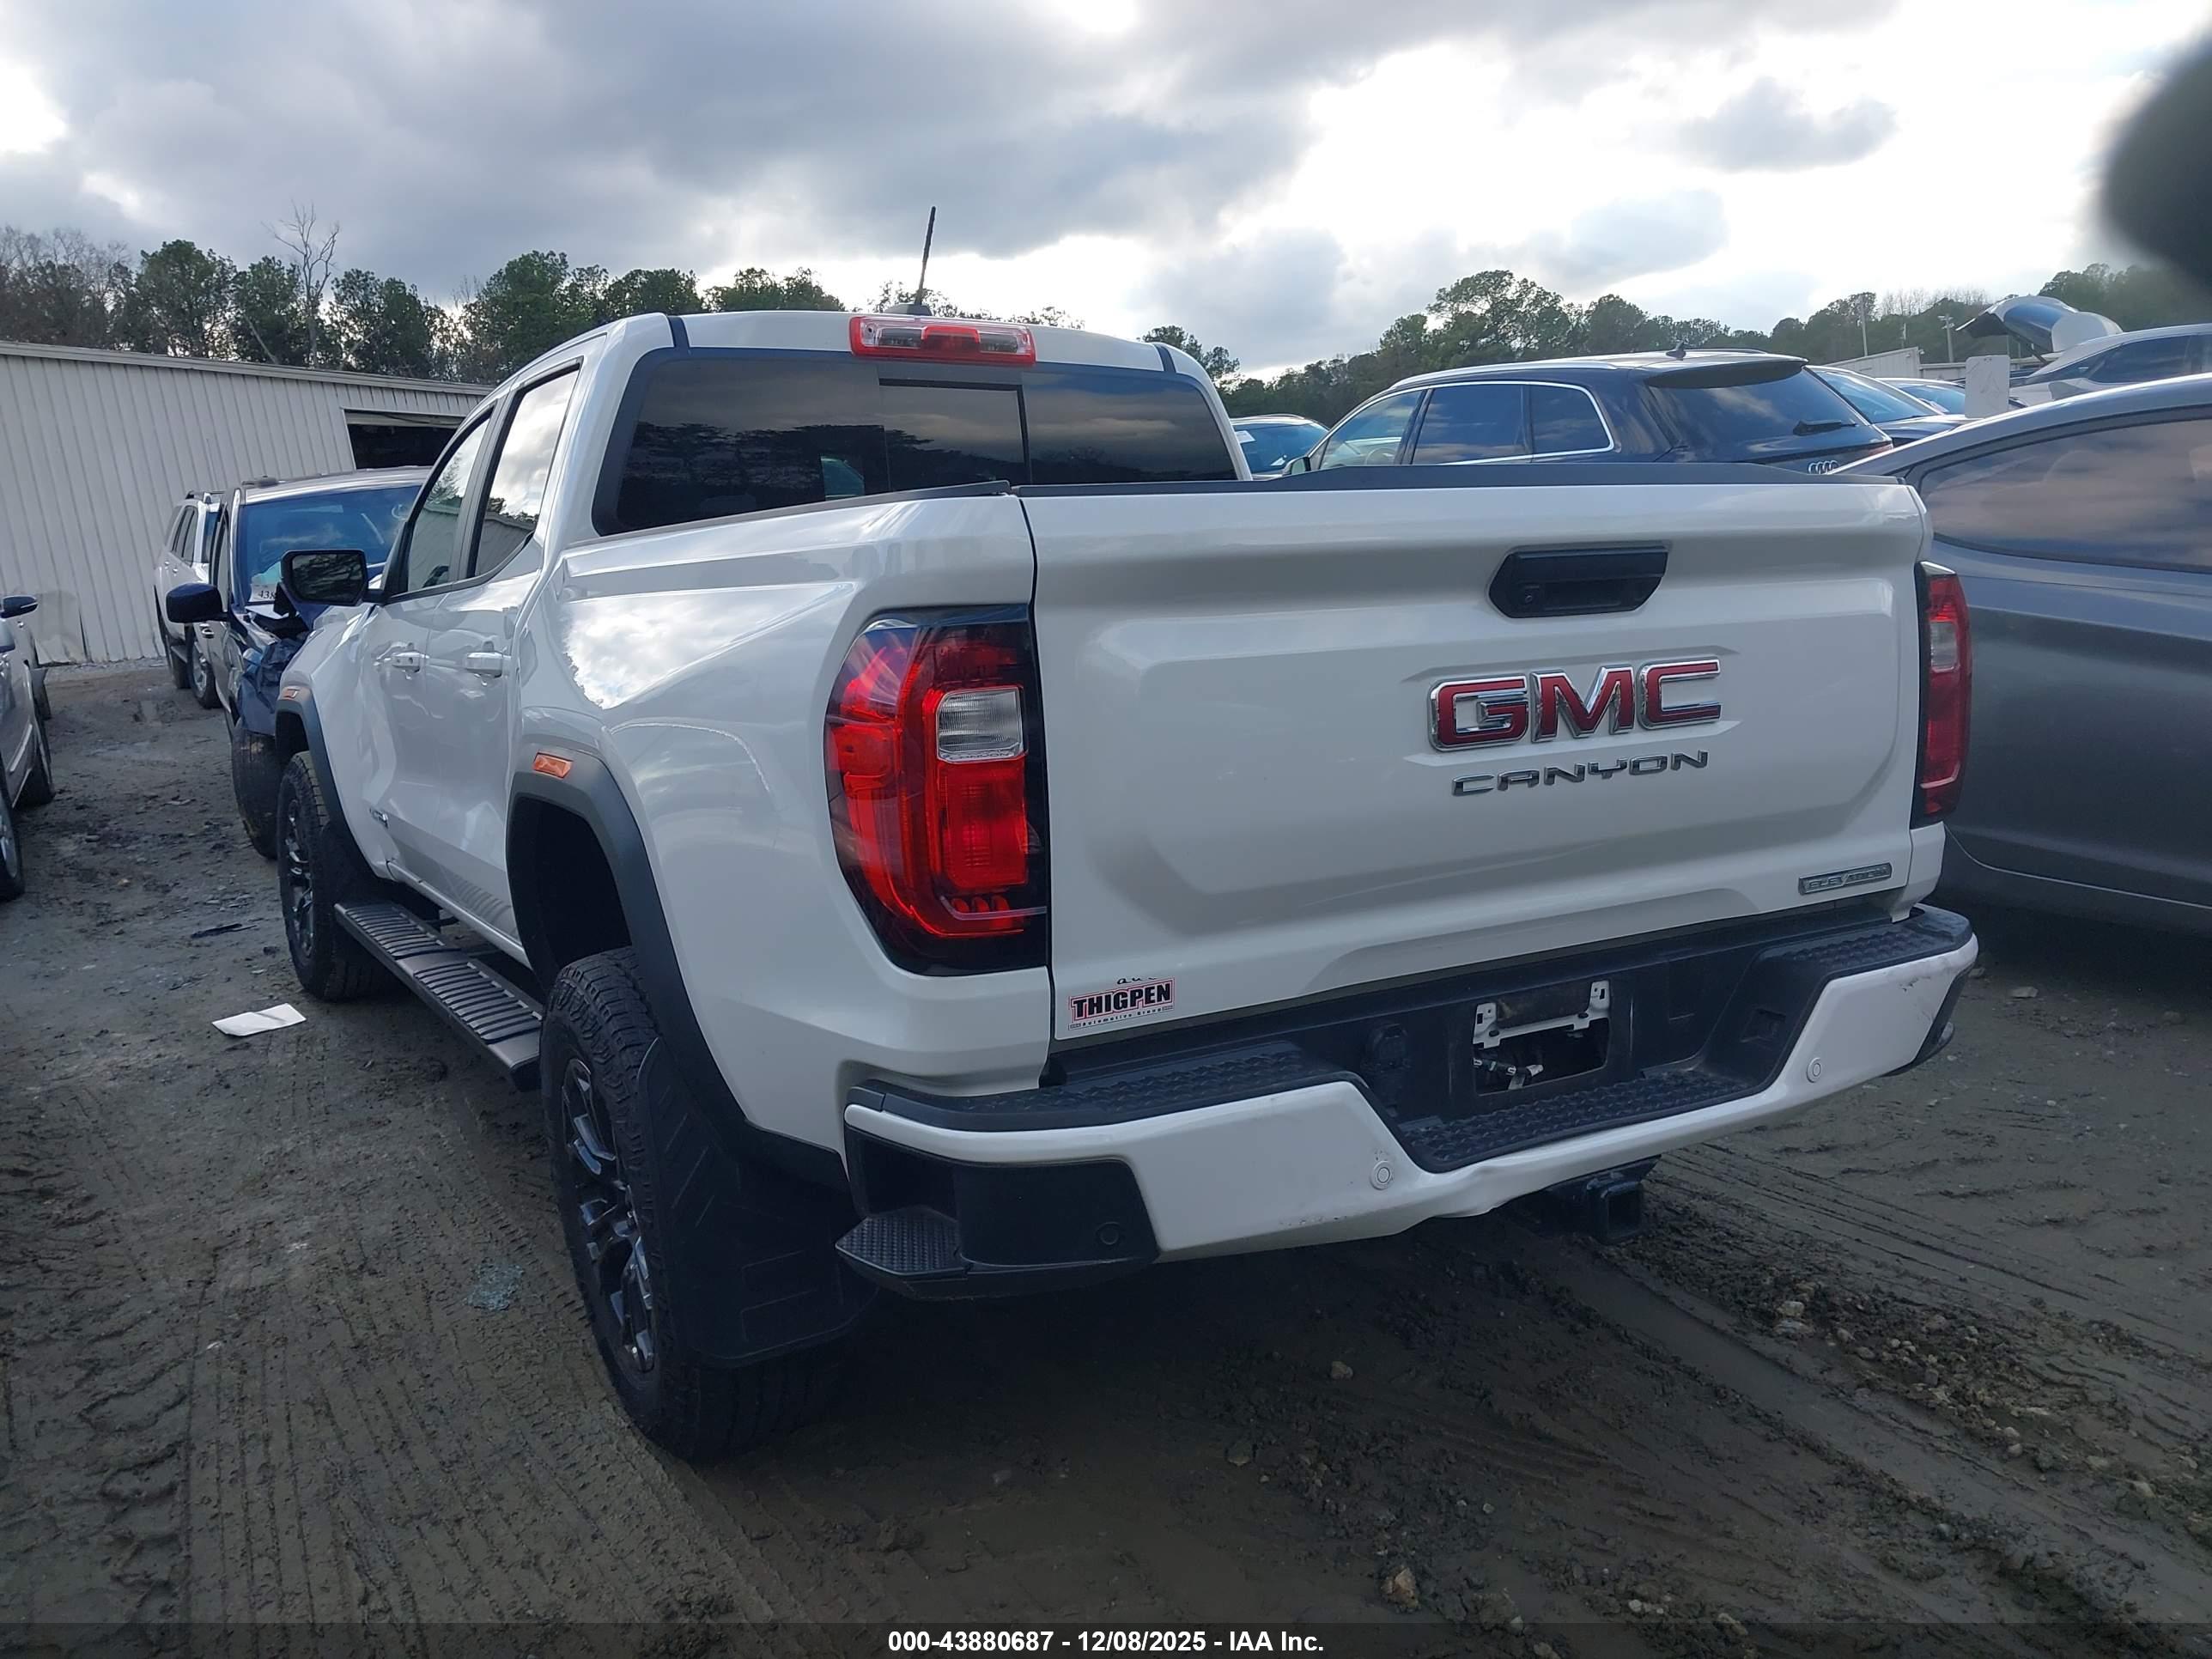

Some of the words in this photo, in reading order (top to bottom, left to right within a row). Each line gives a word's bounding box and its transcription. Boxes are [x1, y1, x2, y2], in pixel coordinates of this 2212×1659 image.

[1428, 657, 1722, 752] GMC
[1452, 750, 1709, 797] CANYON
[1073, 982, 1171, 1018] THIGPEN
